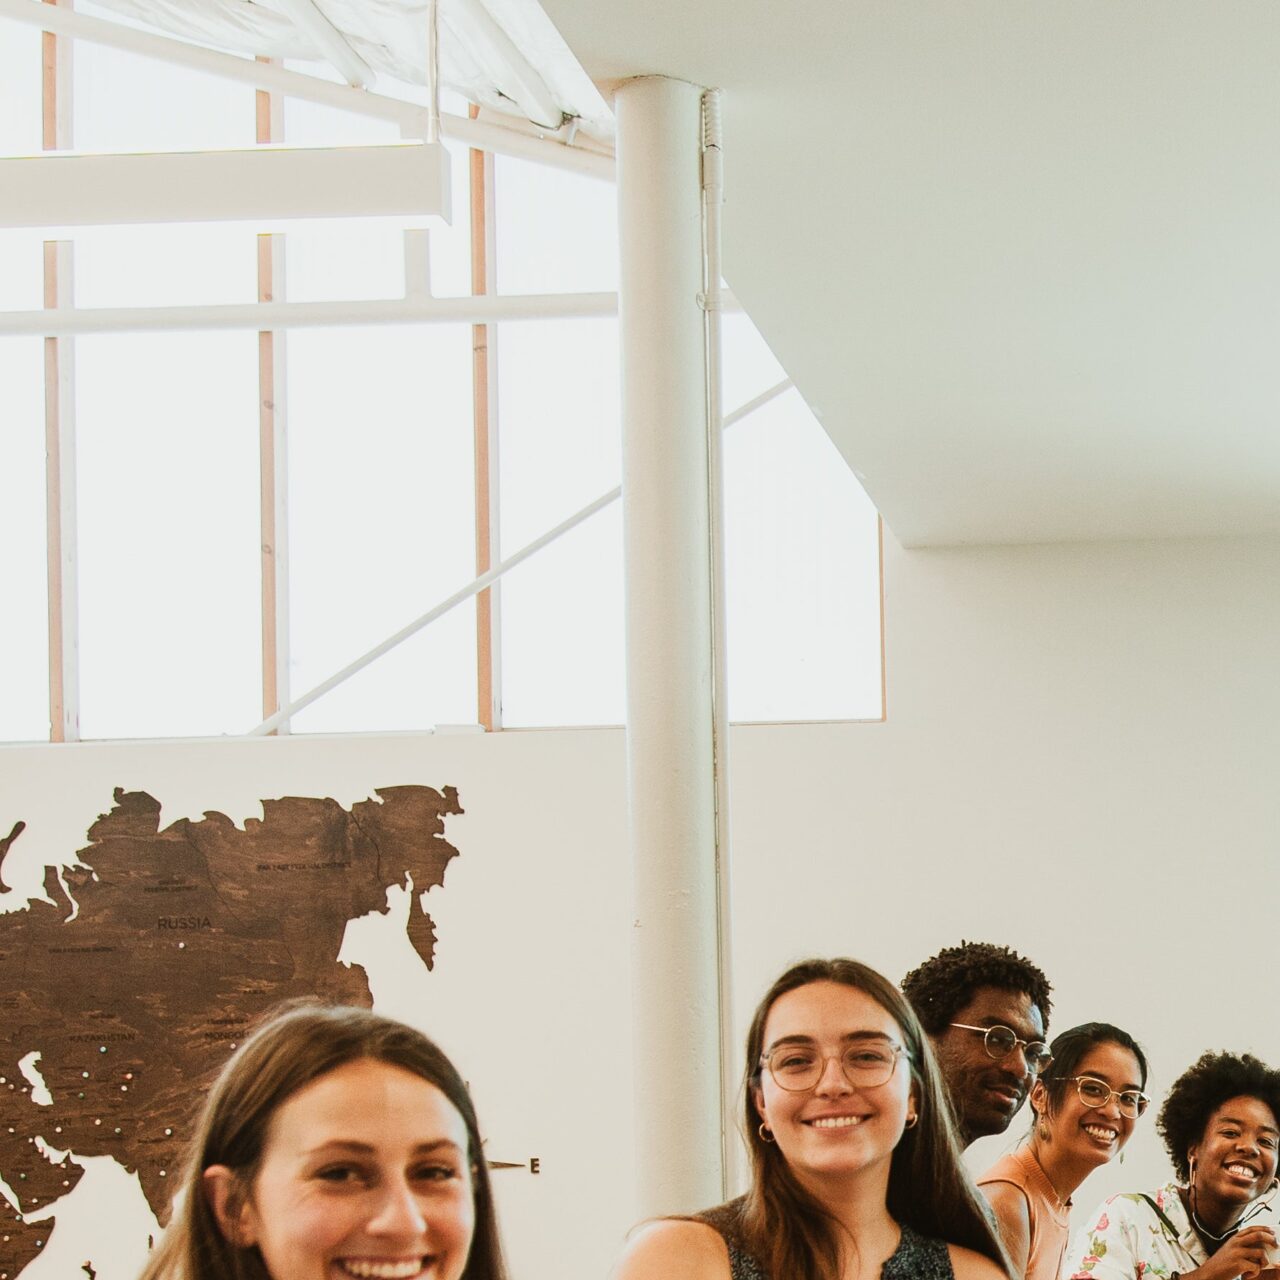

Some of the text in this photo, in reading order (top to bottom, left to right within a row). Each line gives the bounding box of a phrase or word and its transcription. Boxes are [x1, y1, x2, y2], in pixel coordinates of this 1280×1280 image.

[158, 916, 212, 930] RUSSIA
[69, 1033, 135, 1042] KAZAKHSTAN
[204, 1030, 249, 1040] MONGOL
[151, 1158, 173, 1168] INDI
[530, 1158, 540, 1174] E
